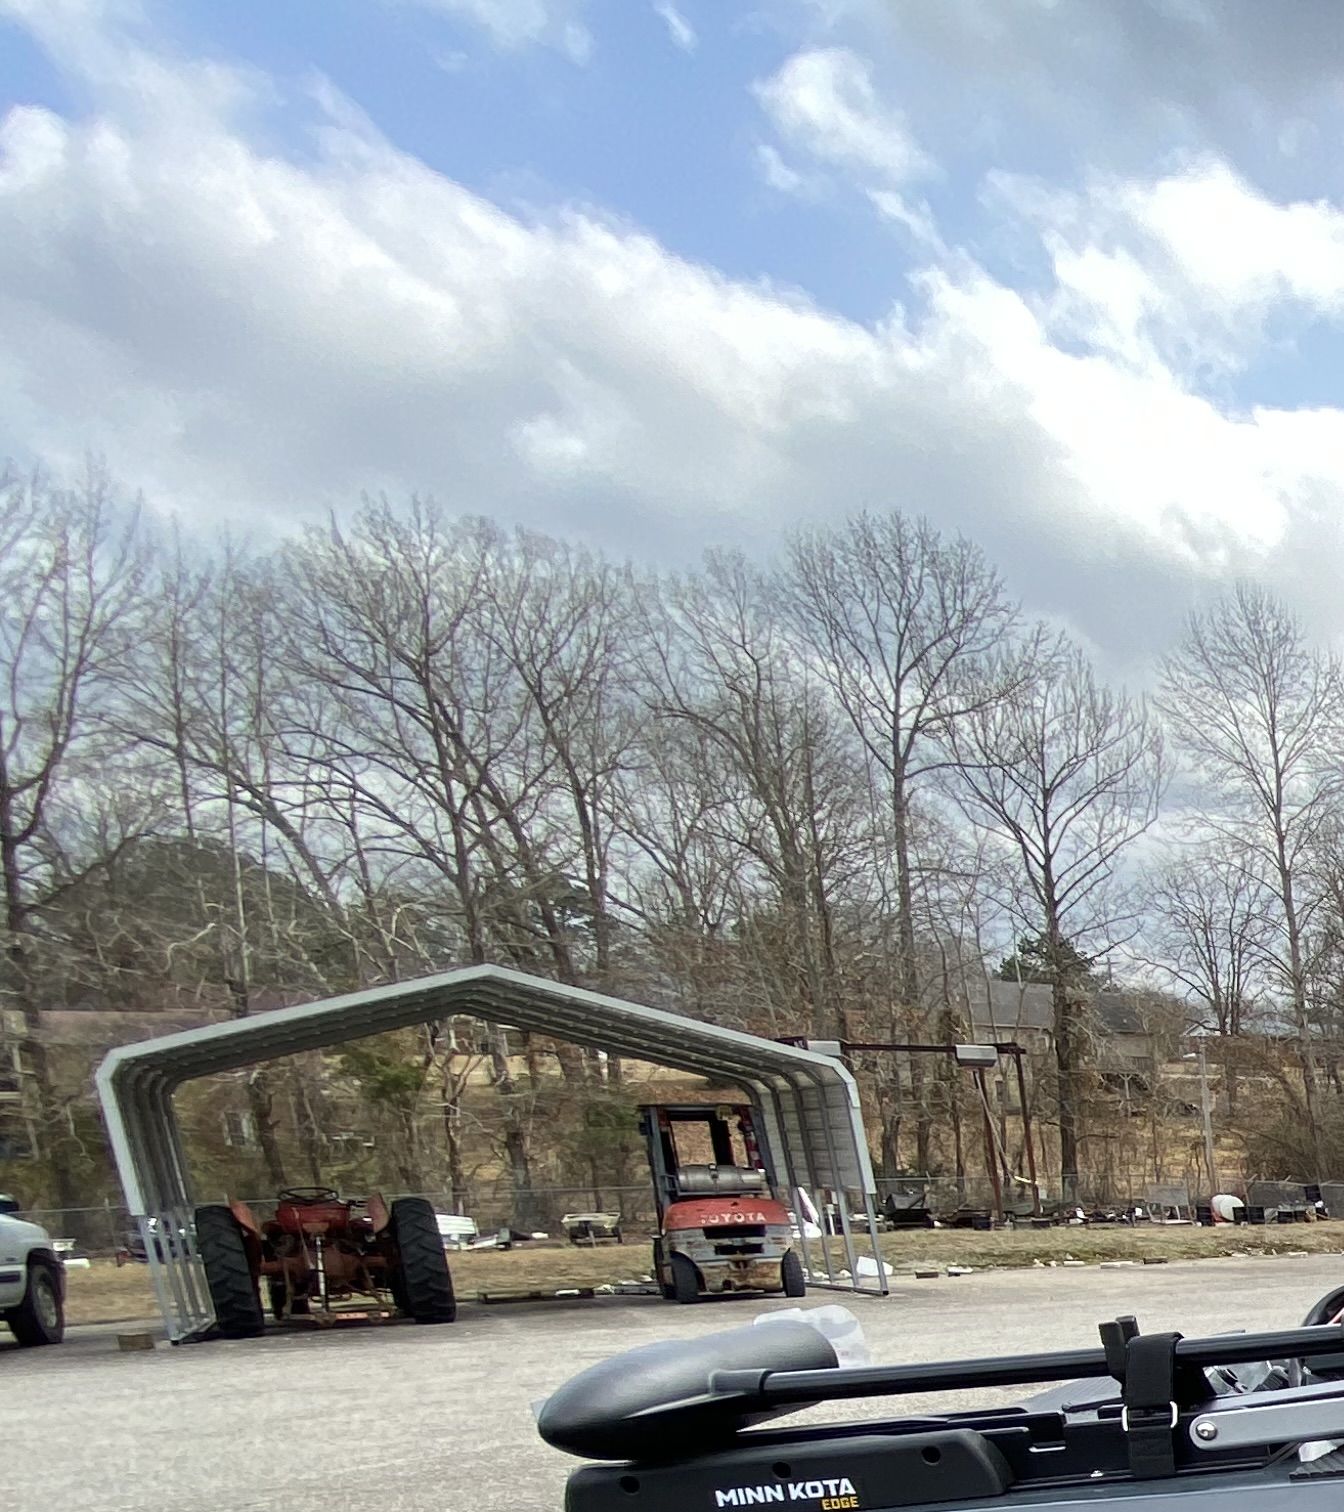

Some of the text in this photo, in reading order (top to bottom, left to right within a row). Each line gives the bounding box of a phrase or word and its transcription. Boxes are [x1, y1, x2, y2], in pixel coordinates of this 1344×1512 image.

[700, 1212, 767, 1224] TOYOTA
[715, 1478, 856, 1507] MINN KOTA
[822, 1496, 860, 1511] EDGE
